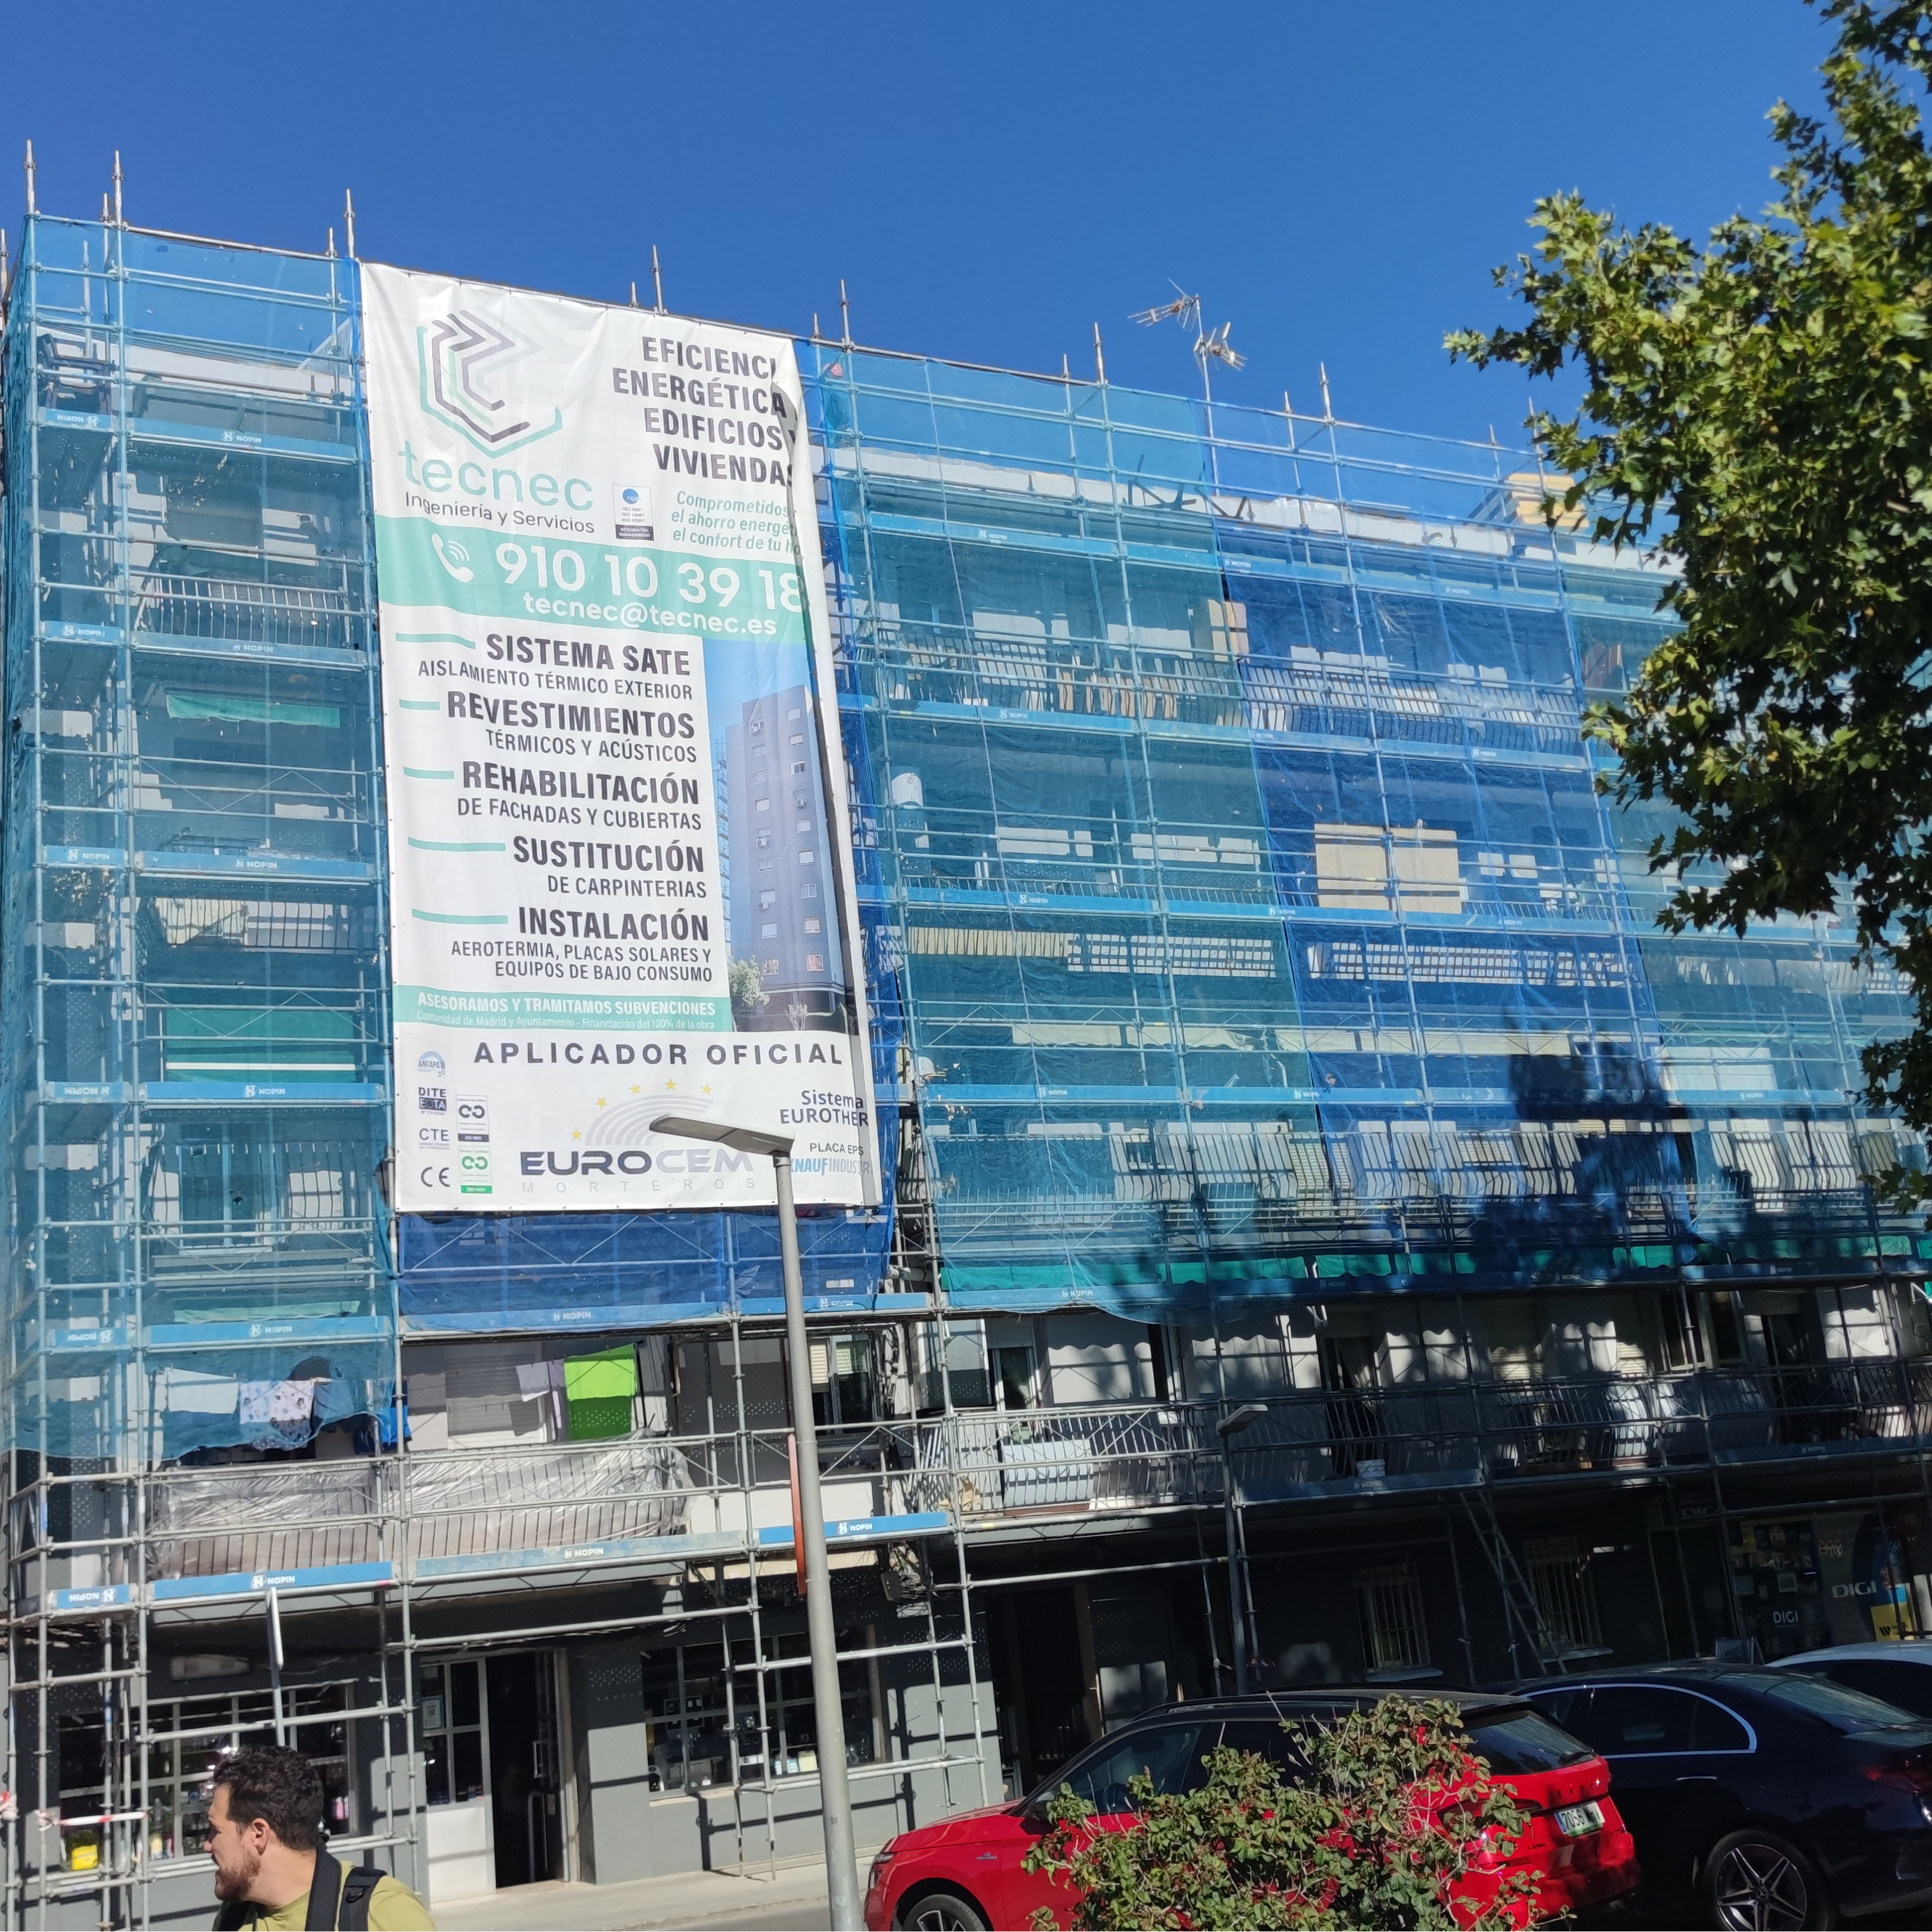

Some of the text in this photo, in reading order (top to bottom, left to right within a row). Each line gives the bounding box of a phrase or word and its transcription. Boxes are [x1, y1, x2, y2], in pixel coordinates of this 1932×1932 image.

[612, 367, 788, 419] ENERGÉTICA
[644, 407, 783, 451] EDIFICIOS
[398, 440, 593, 511] tecnec
[405, 491, 595, 534] Ingeniería y Servicios
[671, 509, 685, 523] el
[688, 512, 736, 530] ahorro
[673, 527, 686, 541] el
[690, 531, 742, 549] confort
[745, 535, 764, 550] de
[767, 539, 782, 552] tu
[495, 542, 806, 614] 910 10 39 18
[523, 592, 777, 635] tecnec@tecnec.es
[243, 644, 274, 653] NOPIN
[486, 633, 691, 676] SISTEMA SATE
[418, 660, 692, 701] AISLAMIENTO TÉRMICO EXTERIOR
[447, 691, 695, 739] REVESTIMIENTOS
[486, 729, 697, 764] TÉRMICOS Y ACÚSTICOS
[463, 760, 699, 806] REHABILITACIÓN
[457, 797, 702, 830] DE FACHADAS Y CUBIERTAS
[82, 852, 110, 860] NOPIN
[246, 860, 278, 869] NOPIN
[513, 835, 705, 873] SUSTITUCIÓN
[548, 875, 707, 899] DE CARPINTERIAS
[519, 906, 710, 942] INSTALACIÓN
[451, 940, 711, 963] AEROTERMIA, PLACAS SOLARES Y
[495, 961, 713, 983] EQUIPOS DE BAJO CONSUMO
[417, 992, 716, 1017] ASESORAMOS Y TRAMITAMOS SUBVENCIONES
[417, 1010, 461, 1025] Comunidad
[463, 1015, 475, 1026] de
[476, 1016, 506, 1027] Madrid
[508, 1018, 515, 1029] y
[516, 1016, 575, 1029] Ayuntamiento
[637, 1018, 650, 1029] del
[652, 1018, 674, 1029] 100%
[676, 1018, 686, 1029] de
[688, 1019, 695, 1030] la
[696, 1019, 715, 1030] obra
[473, 1042, 844, 1066] APLICADOR OFICIAL
[419, 1087, 447, 1098] DITE
[801, 1089, 863, 1109] Sistema
[419, 1128, 450, 1141] CTE
[810, 1143, 864, 1156] PLACA EPS
[520, 1148, 754, 1175] EUROCEM
[522, 1178, 755, 1193] MORTEROS
[562, 1311, 592, 1320] NOPIN
[264, 1326, 293, 1334] NOPIN
[574, 1547, 604, 1557] NOPIN
[268, 1575, 295, 1585] NOPIN
[1832, 1581, 1878, 1598] DIGI
[1773, 1611, 1799, 1624] DIGI
[1562, 1809, 1585, 1830] 7056
